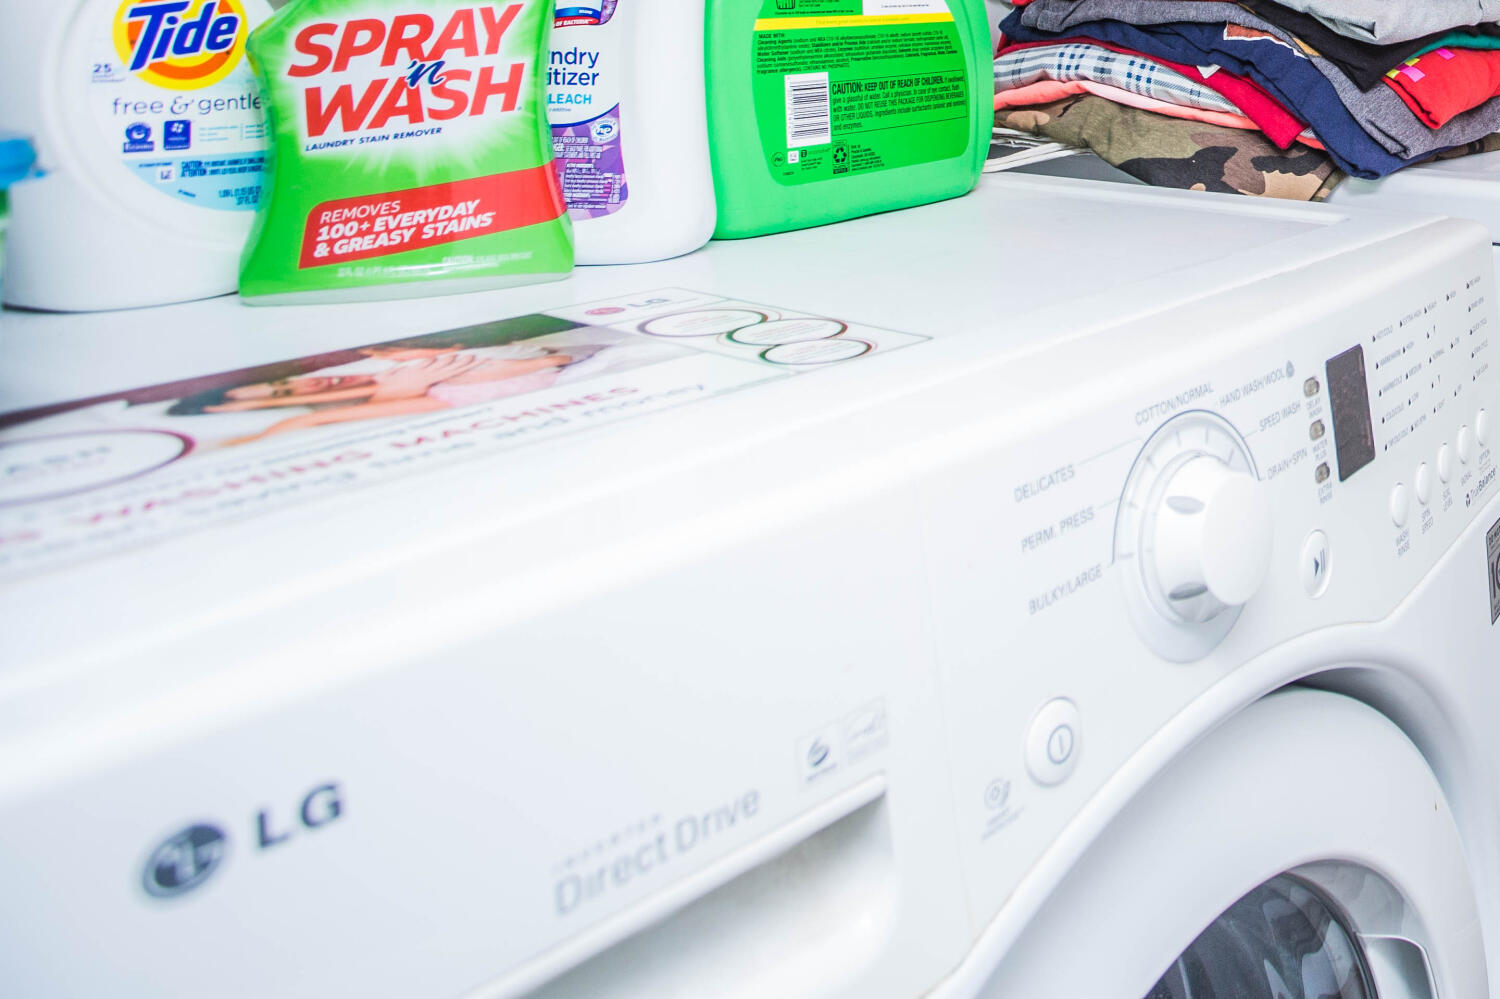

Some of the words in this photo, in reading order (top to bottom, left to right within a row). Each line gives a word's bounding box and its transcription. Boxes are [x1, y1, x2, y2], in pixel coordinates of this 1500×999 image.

[287, 3, 524, 78] SPRAY
[550, 46, 600, 68] ndry
[547, 67, 600, 86] itizer
[832, 82, 864, 96] CAUTION:
[864, 82, 878, 92] KEEP
[878, 81, 888, 90] OUT
[890, 80, 896, 89] OF
[898, 78, 914, 88] REACH
[914, 78, 921, 86] OF
[113, 97, 164, 115] free
[170, 96, 195, 115] &
[198, 93, 262, 114] gentle
[304, 62, 525, 138] WASH
[548, 93, 592, 105] LEACH
[306, 138, 356, 152] LAUNDRY
[359, 134, 390, 145] STAIN
[394, 127, 442, 140] REMOVER
[316, 222, 371, 242] 100+
[373, 199, 480, 232] EVERYDAY
[320, 200, 401, 224] REMOVES
[313, 242, 330, 258] &
[334, 229, 416, 256] GREASY
[422, 212, 495, 240] STAINS
[389, 385, 641, 450] MACHINES
[1134, 382, 1214, 426] COTTON/NORMAL
[1219, 388, 1240, 408] HAND
[1259, 411, 1280, 432] SPEED
[1282, 402, 1302, 419] WASH
[1014, 464, 1076, 502] DELICATES
[1021, 526, 1056, 552] PERM.
[1060, 506, 1095, 534] PRESS
[1028, 564, 1103, 616] BULKY/LARGE
[256, 782, 343, 850] LG
[553, 831, 669, 917] Direct
[674, 788, 762, 855] Drive
